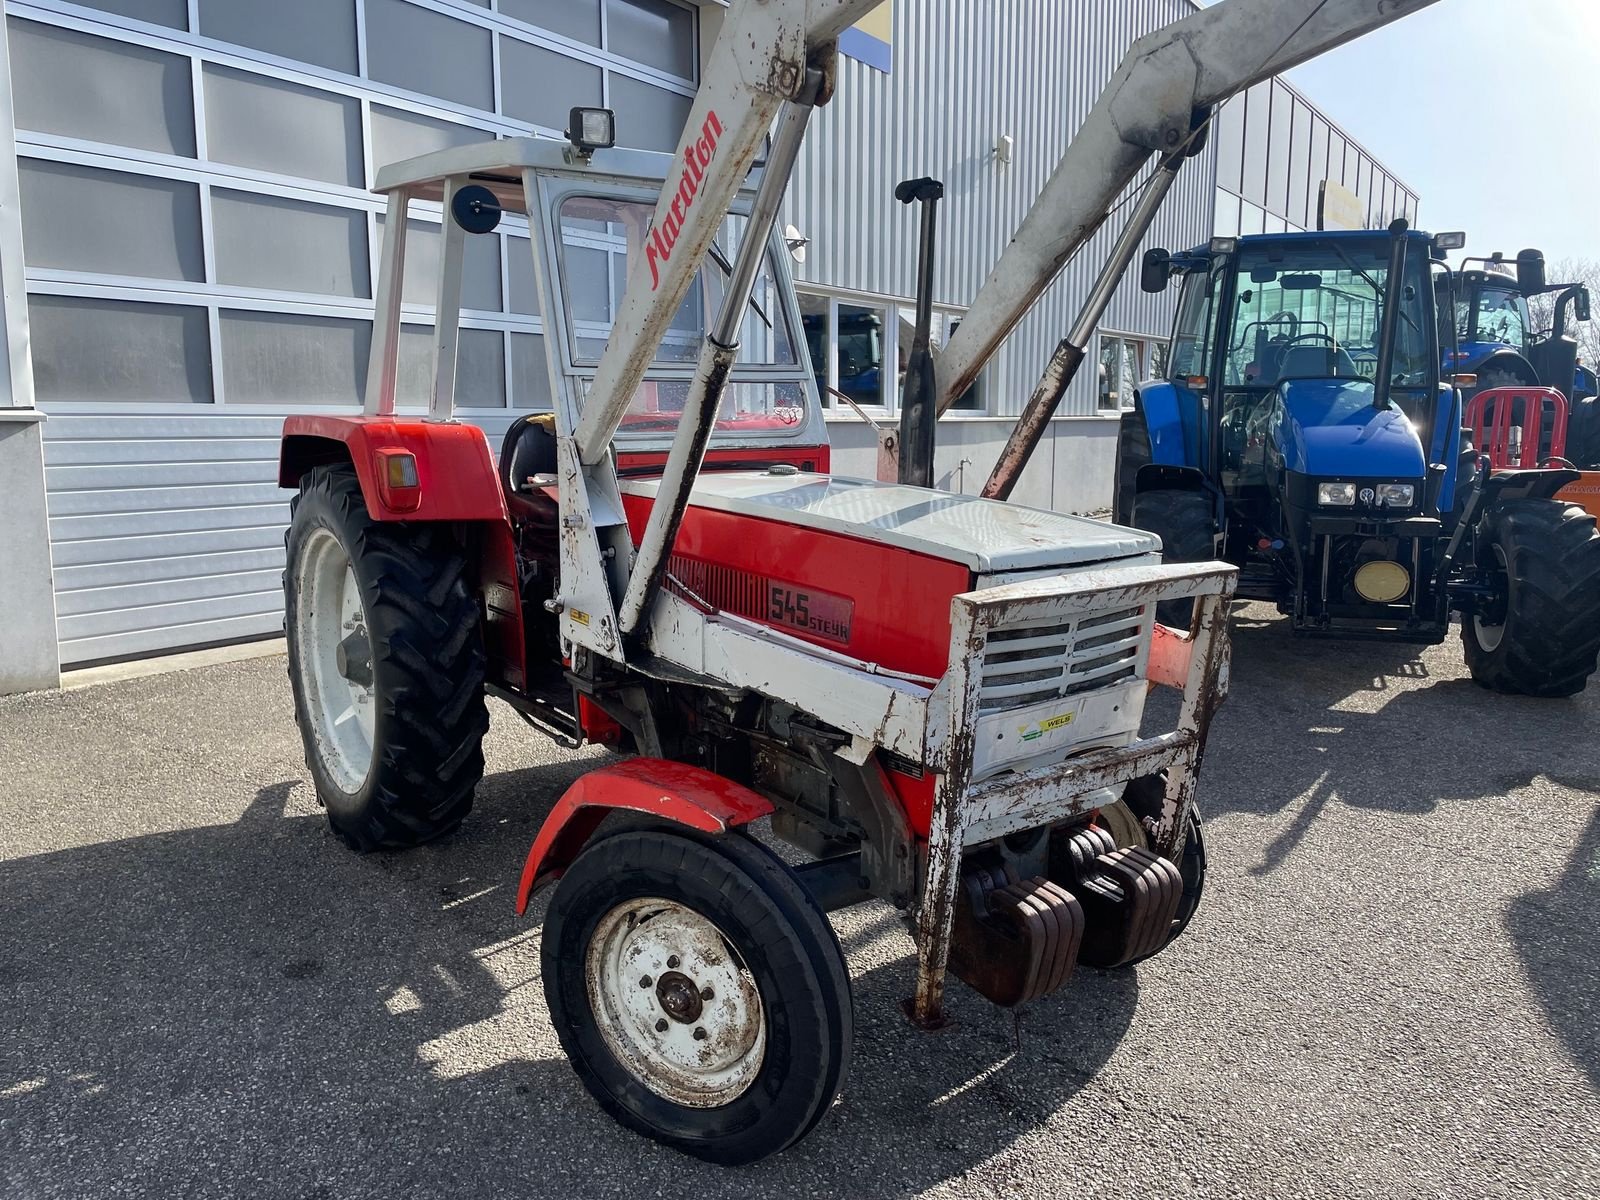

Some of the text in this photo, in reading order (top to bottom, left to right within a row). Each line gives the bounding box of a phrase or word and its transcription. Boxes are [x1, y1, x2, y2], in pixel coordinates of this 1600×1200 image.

[646, 110, 723, 291] Maraton
[771, 587, 849, 640] 545 STEYR
[1047, 716, 1071, 728] WELS
